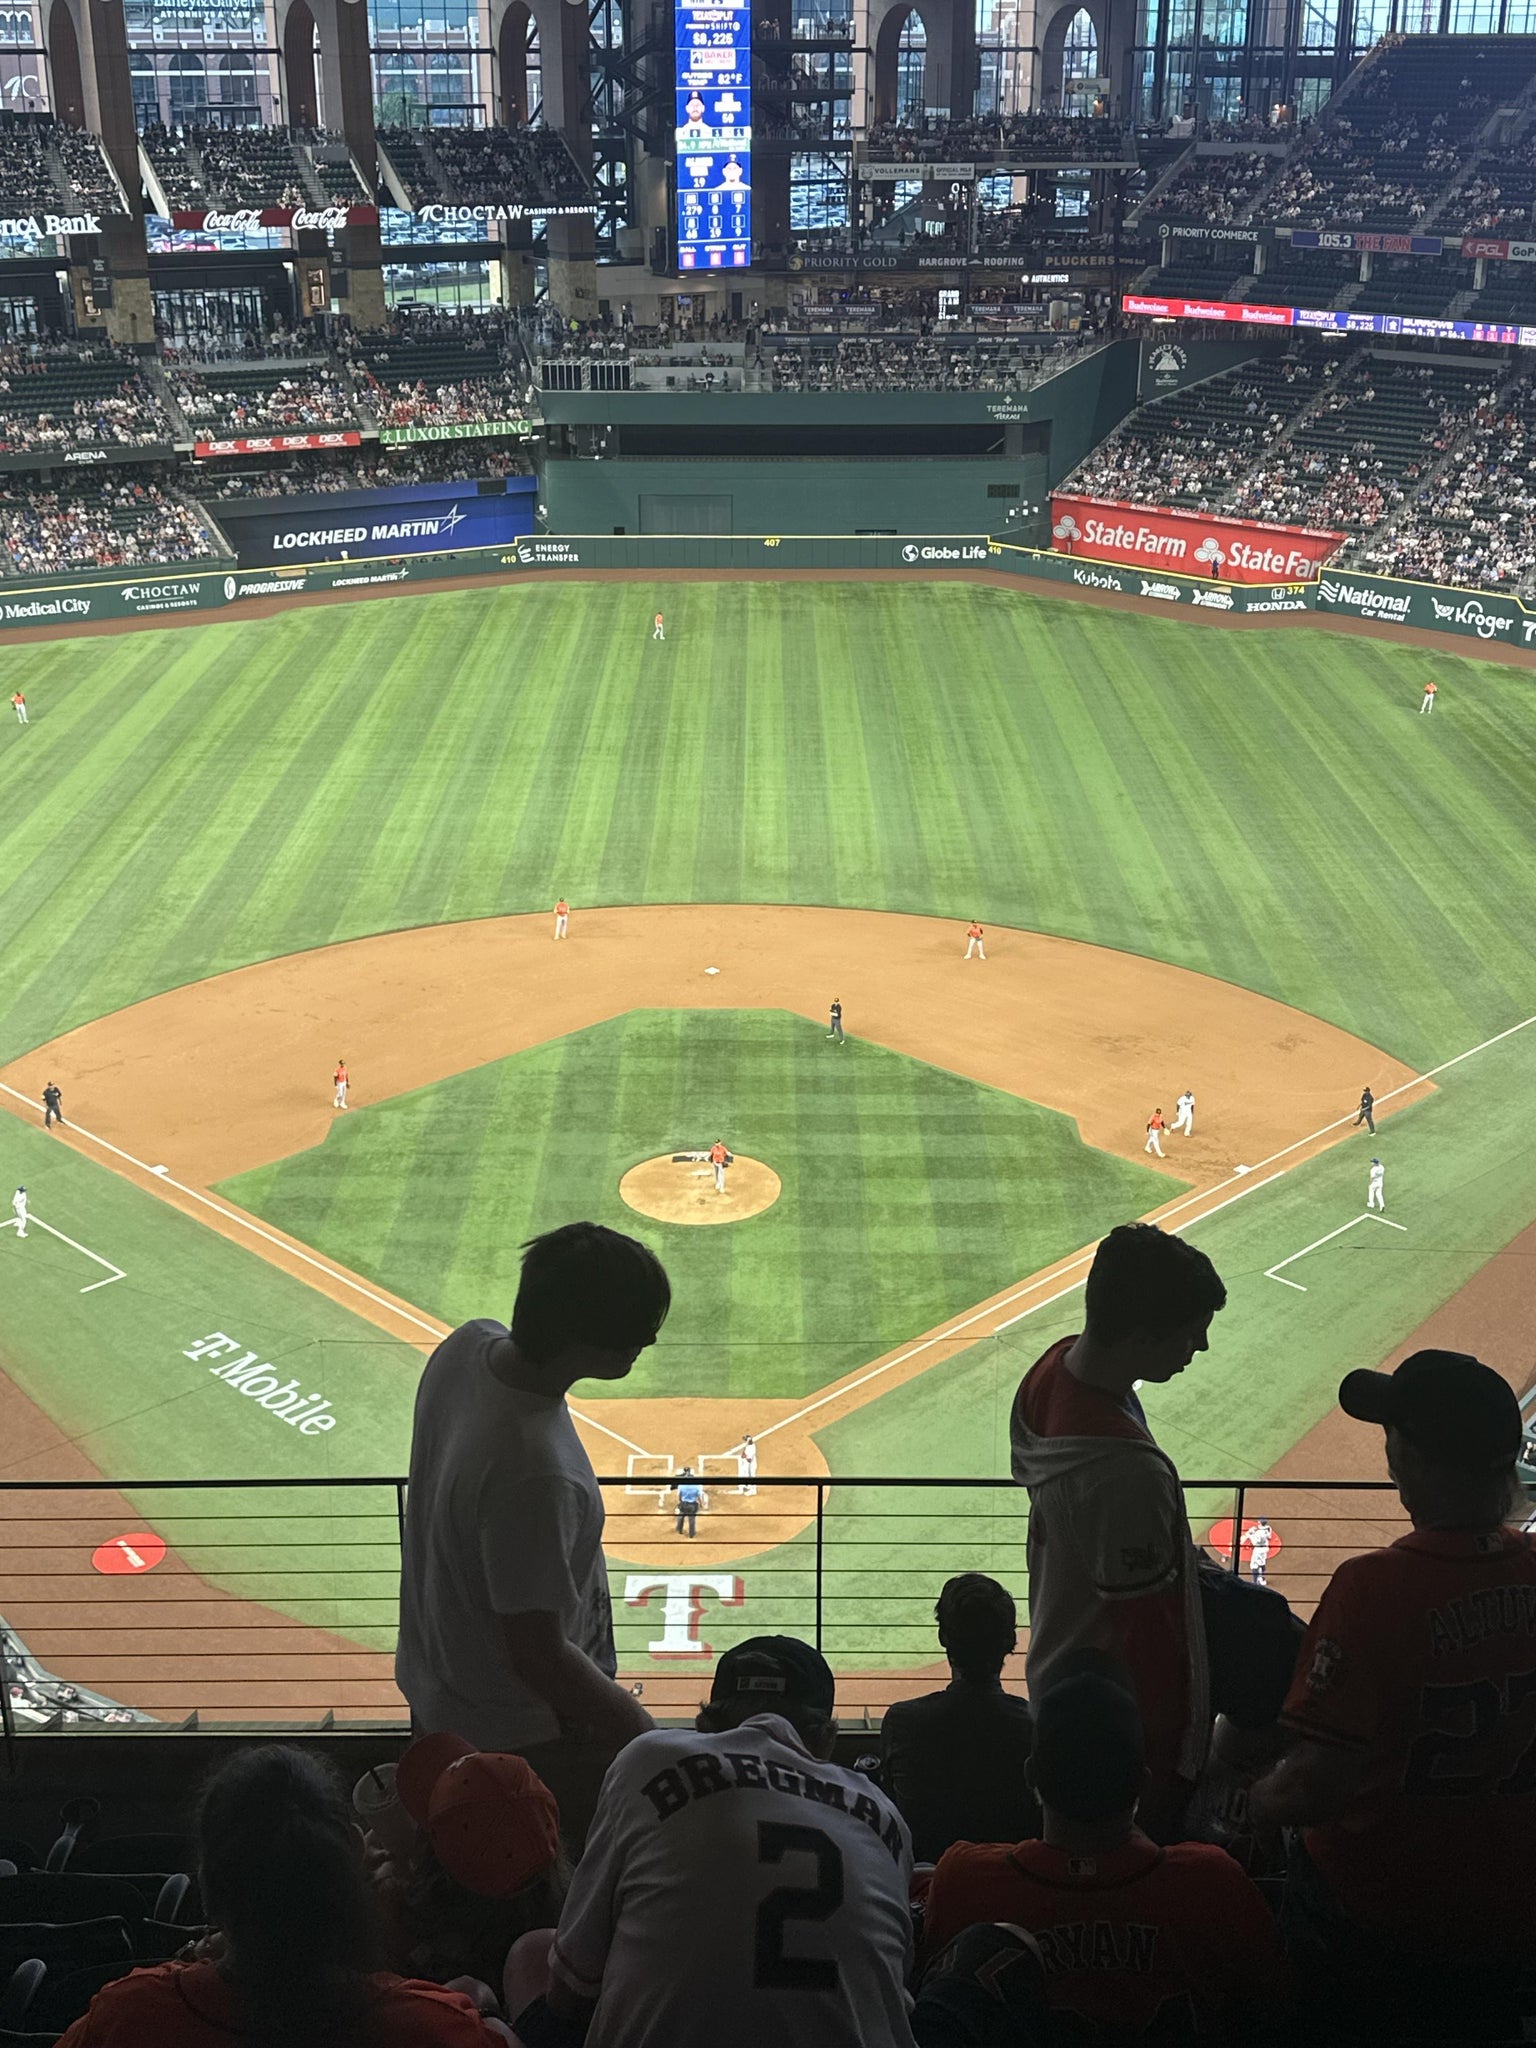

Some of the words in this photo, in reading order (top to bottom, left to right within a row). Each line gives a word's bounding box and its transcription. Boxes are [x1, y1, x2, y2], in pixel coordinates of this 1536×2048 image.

[692, 32, 734, 47] $8,225
[704, 51, 733, 59] BAKER
[291, 206, 350, 230] Coca-Cola
[429, 204, 523, 222] CHOCTAW
[524, 206, 557, 216] CASINOS
[43, 212, 103, 235] Bank
[202, 209, 263, 233] Coca-Cola
[1172, 226, 1210, 239] PRIORITY
[1211, 229, 1259, 242] COMMERCE
[1317, 233, 1352, 248] 105.3
[1354, 235, 1380, 250] THE
[1382, 236, 1412, 251] FAN
[1475, 242, 1504, 256] PGL
[804, 257, 860, 268] PRIORITY
[862, 257, 897, 268] GOLD
[918, 257, 968, 267] HARGROVE
[983, 257, 1025, 267] ROOFING
[1045, 255, 1116, 267] PLUCKERS
[1031, 274, 1070, 283] AUTHENTICS
[1128, 299, 1169, 313] Budweiser
[1183, 304, 1226, 318] Budweiser
[1241, 308, 1286, 322] Budweiser
[1346, 320, 1375, 331] $8,225
[986, 405, 1029, 413] TEREMANA
[318, 433, 344, 444] DEX
[396, 426, 451, 443] LUXOR
[452, 420, 530, 440] STAFFING
[208, 440, 236, 451] DEX
[246, 438, 273, 449] DEX
[282, 435, 309, 446] DEX
[64, 450, 108, 462] ARENA
[273, 527, 368, 550] LOCKHEED
[371, 520, 440, 541] MARTIN
[535, 543, 570, 553] ENERGY
[763, 538, 781, 548] 407
[500, 555, 518, 564] 410
[535, 553, 580, 563] TRANSFER
[920, 546, 960, 560] Globe
[962, 545, 987, 560] Life
[238, 578, 306, 596] PROGRESSIVE
[331, 576, 370, 587] LOCKHEED
[370, 573, 399, 583] MARTIN
[1073, 568, 1122, 592] Kubota
[129, 582, 201, 600] CHOCTAW
[1286, 585, 1305, 596] 374
[1337, 585, 1409, 613] National
[5, 600, 62, 619] Medical
[62, 598, 91, 615] City
[1246, 600, 1308, 613] HONDA
[1360, 607, 1377, 617] Car
[1377, 610, 1406, 623] Rental
[1455, 600, 1514, 639] Kroger
[752, 1819, 845, 1991] 2
